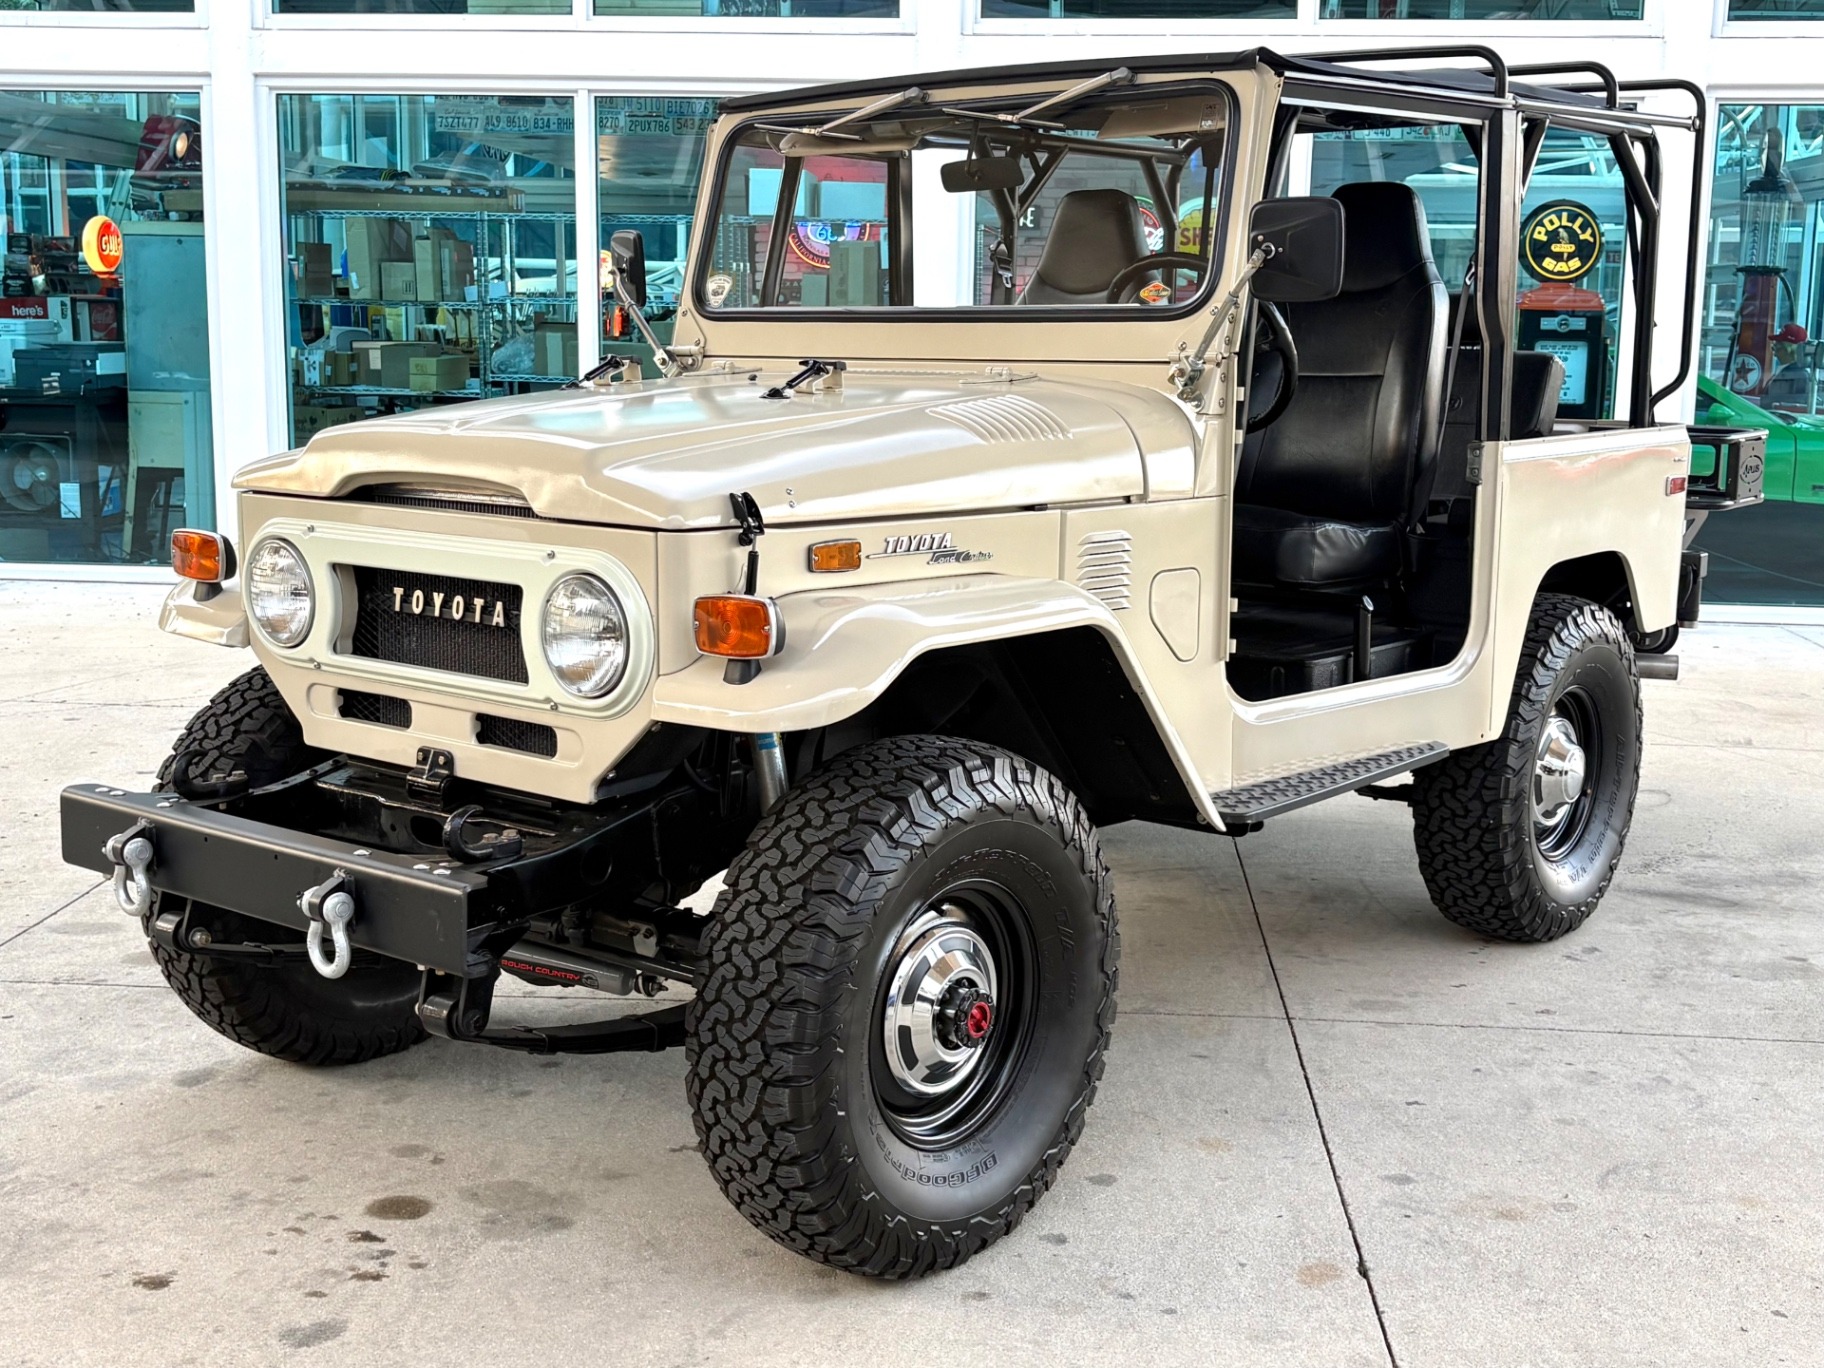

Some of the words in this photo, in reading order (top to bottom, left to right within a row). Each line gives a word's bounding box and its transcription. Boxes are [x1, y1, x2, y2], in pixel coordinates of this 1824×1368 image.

[628, 119, 670, 132] 2PUX786
[1533, 212, 1594, 243] POLLY
[1542, 257, 1582, 273] GAS
[11, 305, 44, 316] here's
[885, 532, 952, 554] TOYOTA
[393, 586, 505, 628] TOYOTA
[535, 966, 581, 981] COUNTRY
